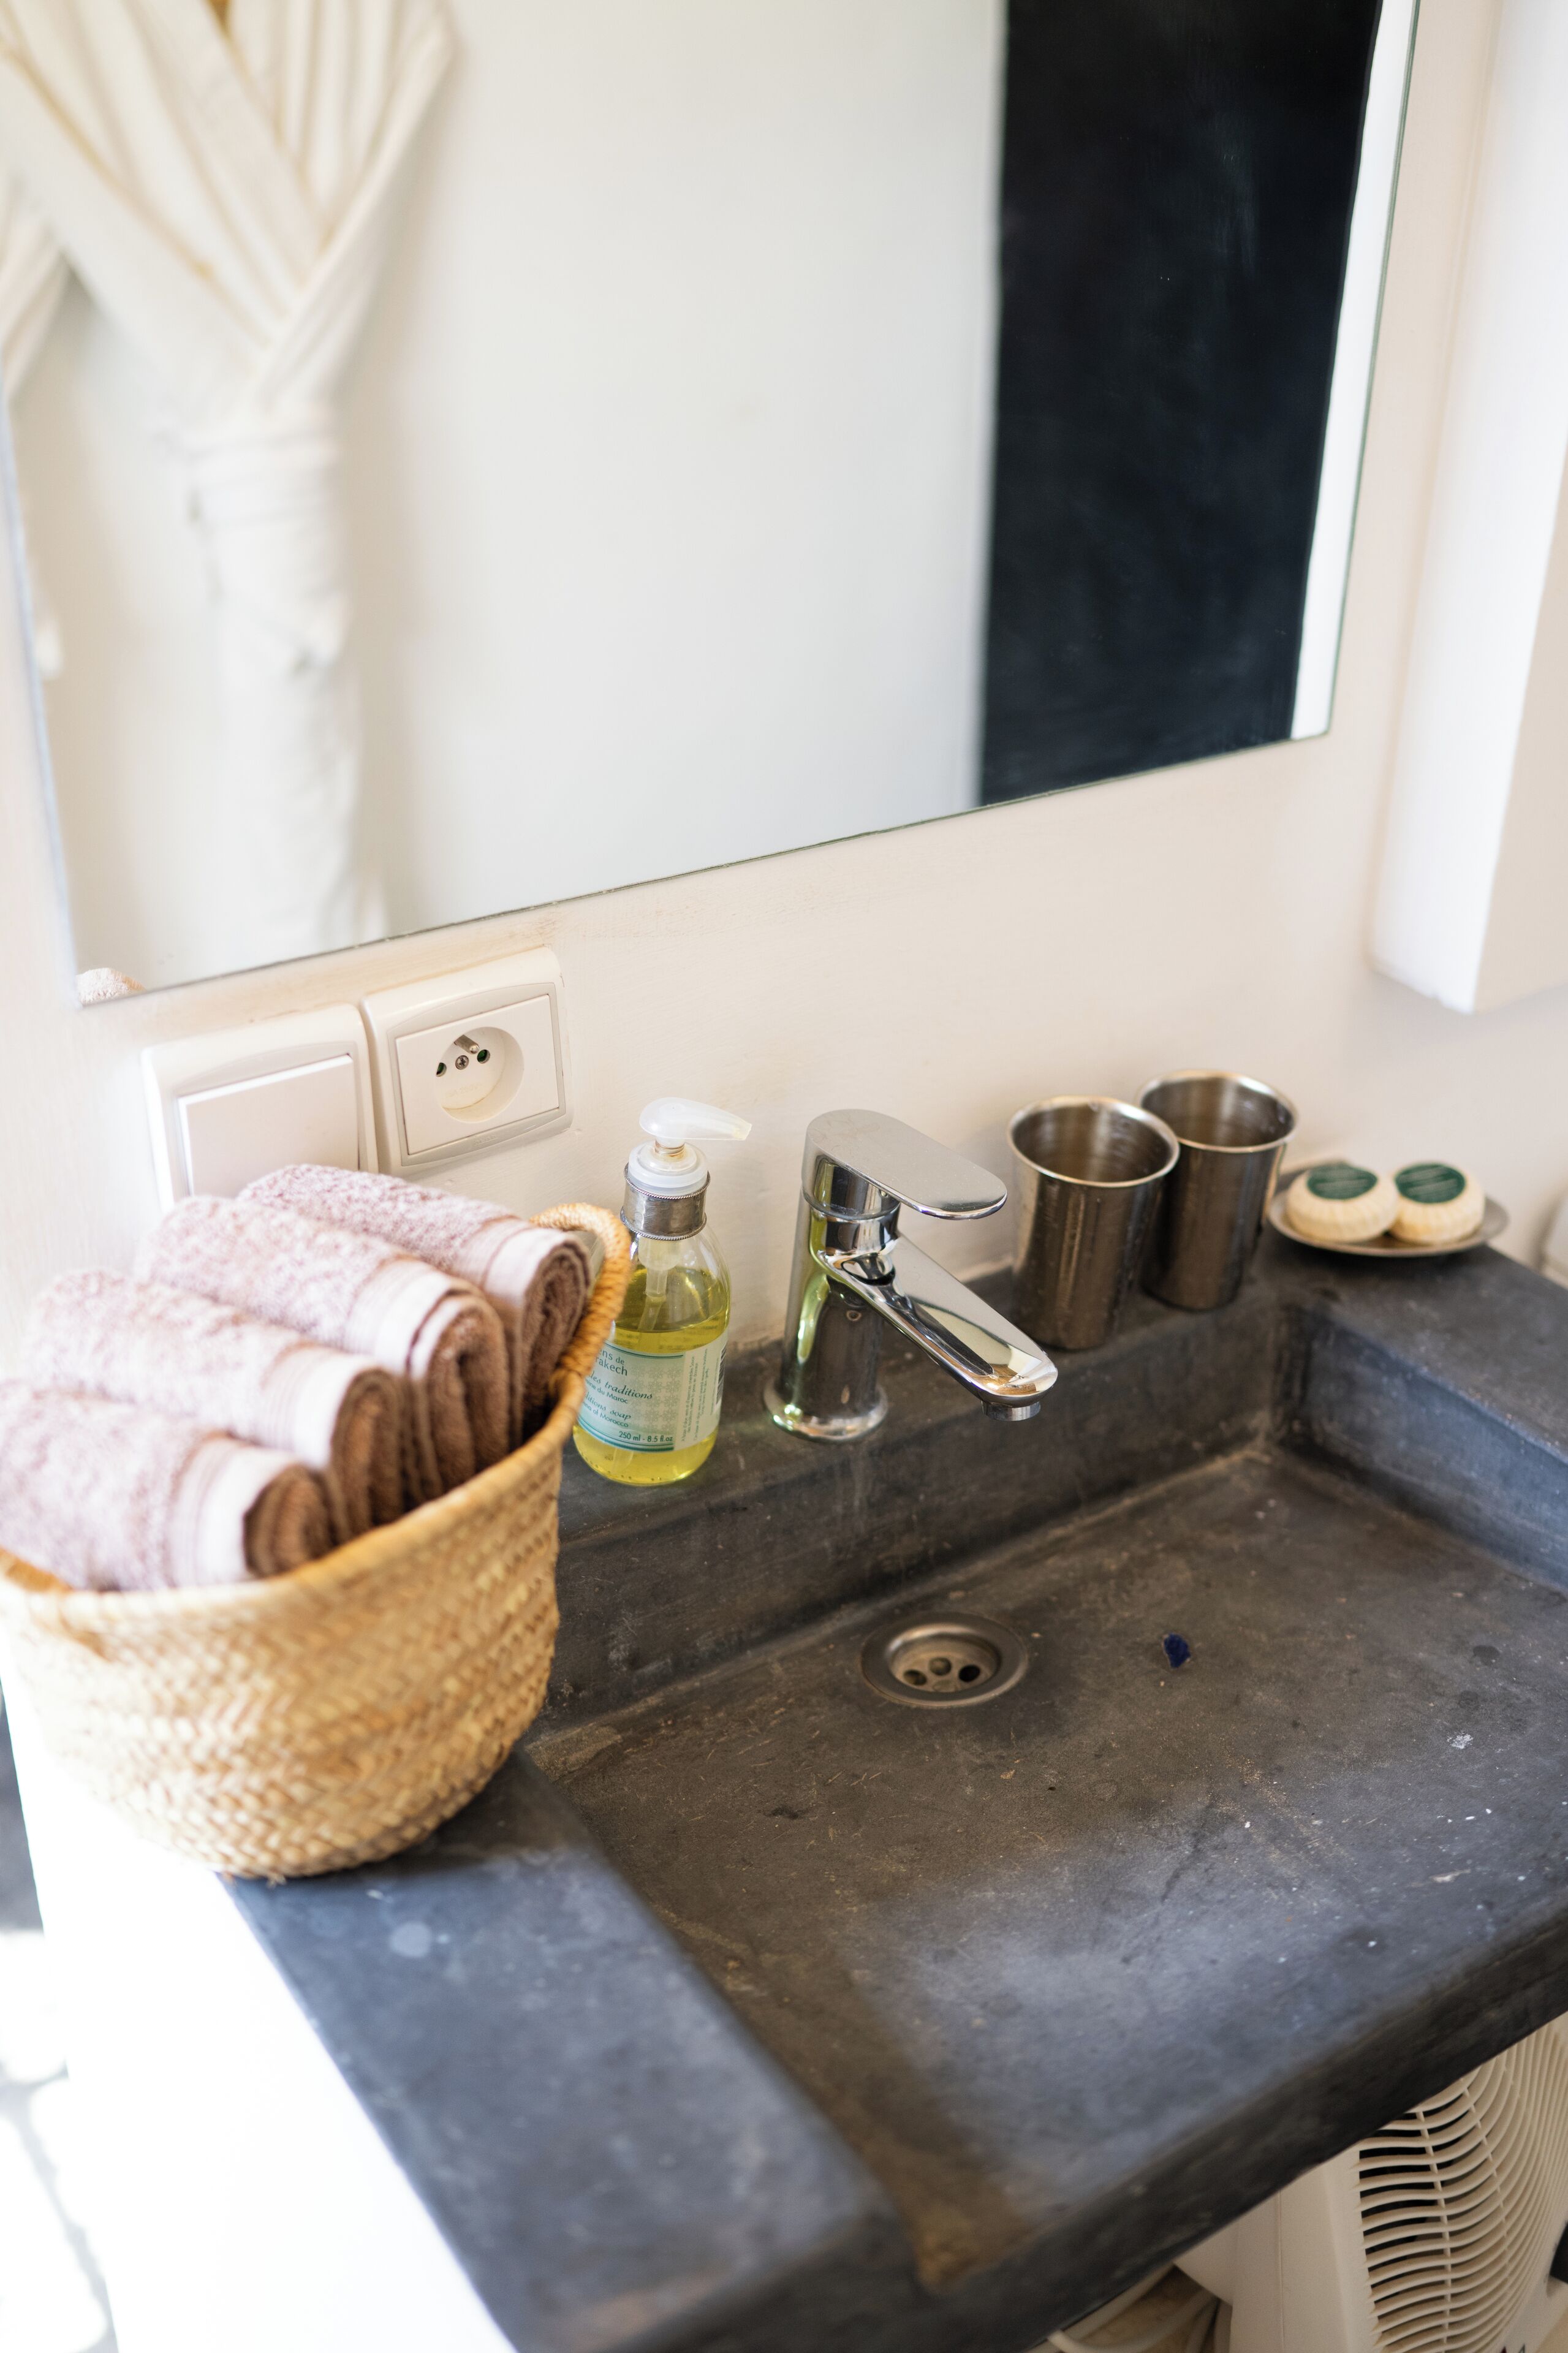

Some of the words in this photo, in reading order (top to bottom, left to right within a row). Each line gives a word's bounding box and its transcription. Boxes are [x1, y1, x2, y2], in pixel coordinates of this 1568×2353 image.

[605, 1381, 653, 1399] traditions
[607, 1392, 628, 1404] Maroc
[600, 1412, 629, 1428] Morocco
[610, 1410, 632, 1421] soap
[619, 1431, 631, 1440] 250
